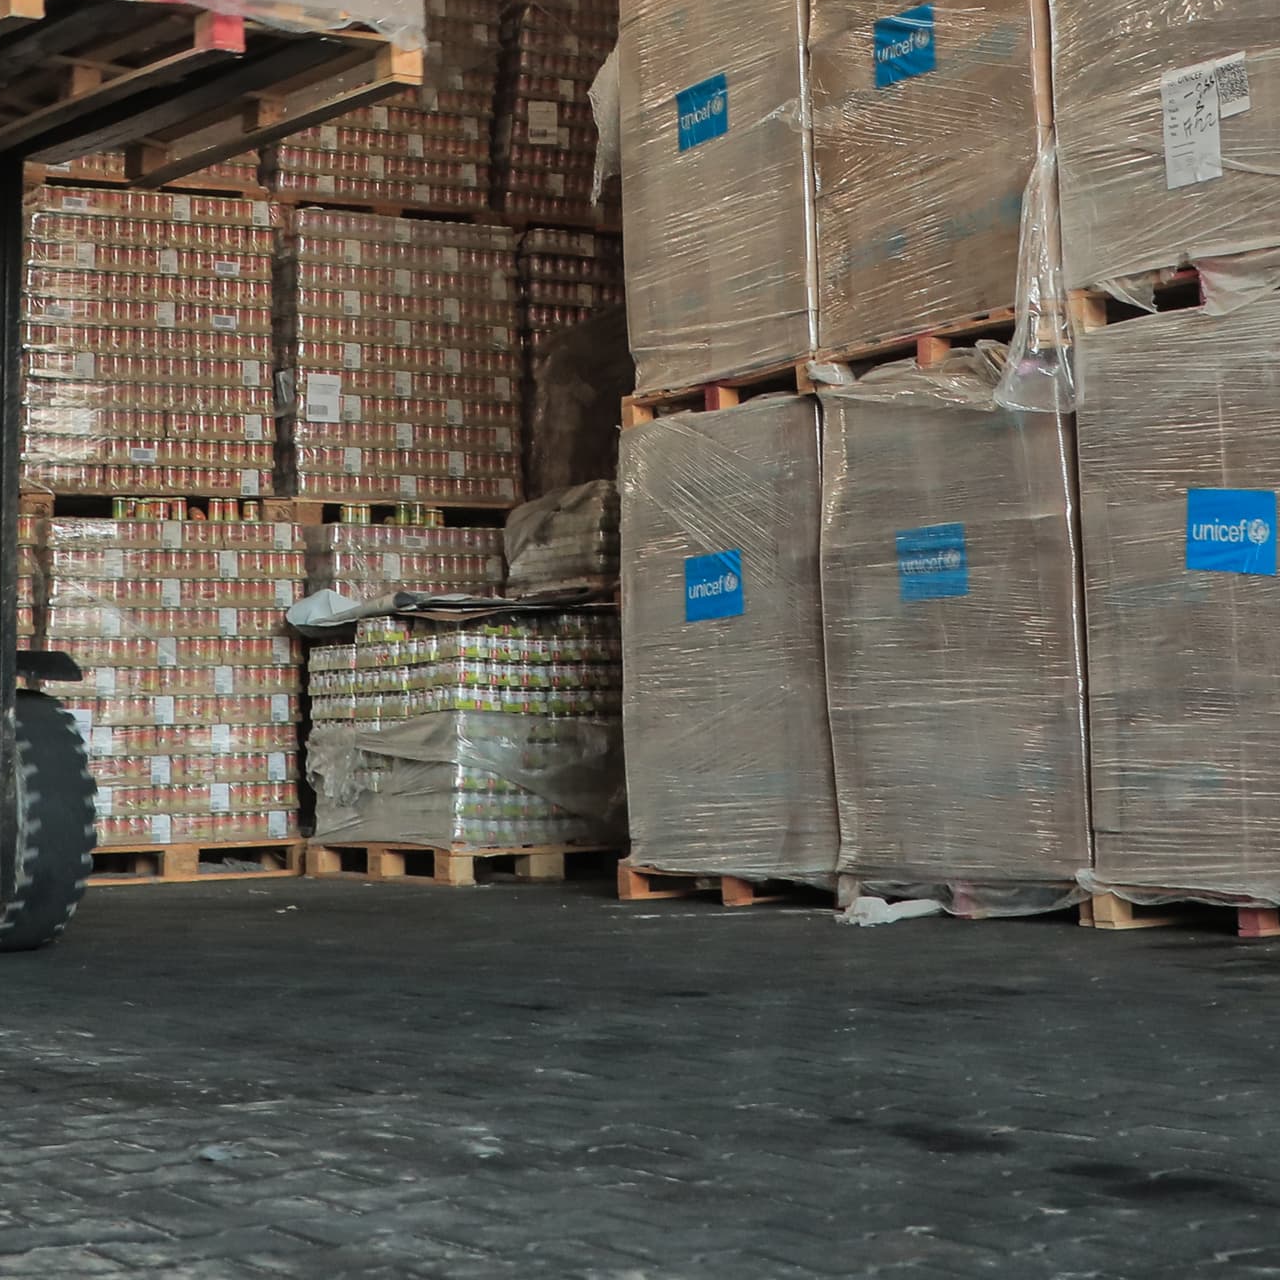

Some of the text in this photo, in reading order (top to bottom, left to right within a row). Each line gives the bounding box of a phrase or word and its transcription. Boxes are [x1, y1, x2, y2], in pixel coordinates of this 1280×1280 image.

[877, 32, 915, 63] unicef
[680, 100, 712, 130] unicef
[1192, 517, 1247, 543] unicef
[688, 575, 724, 600] unicef
